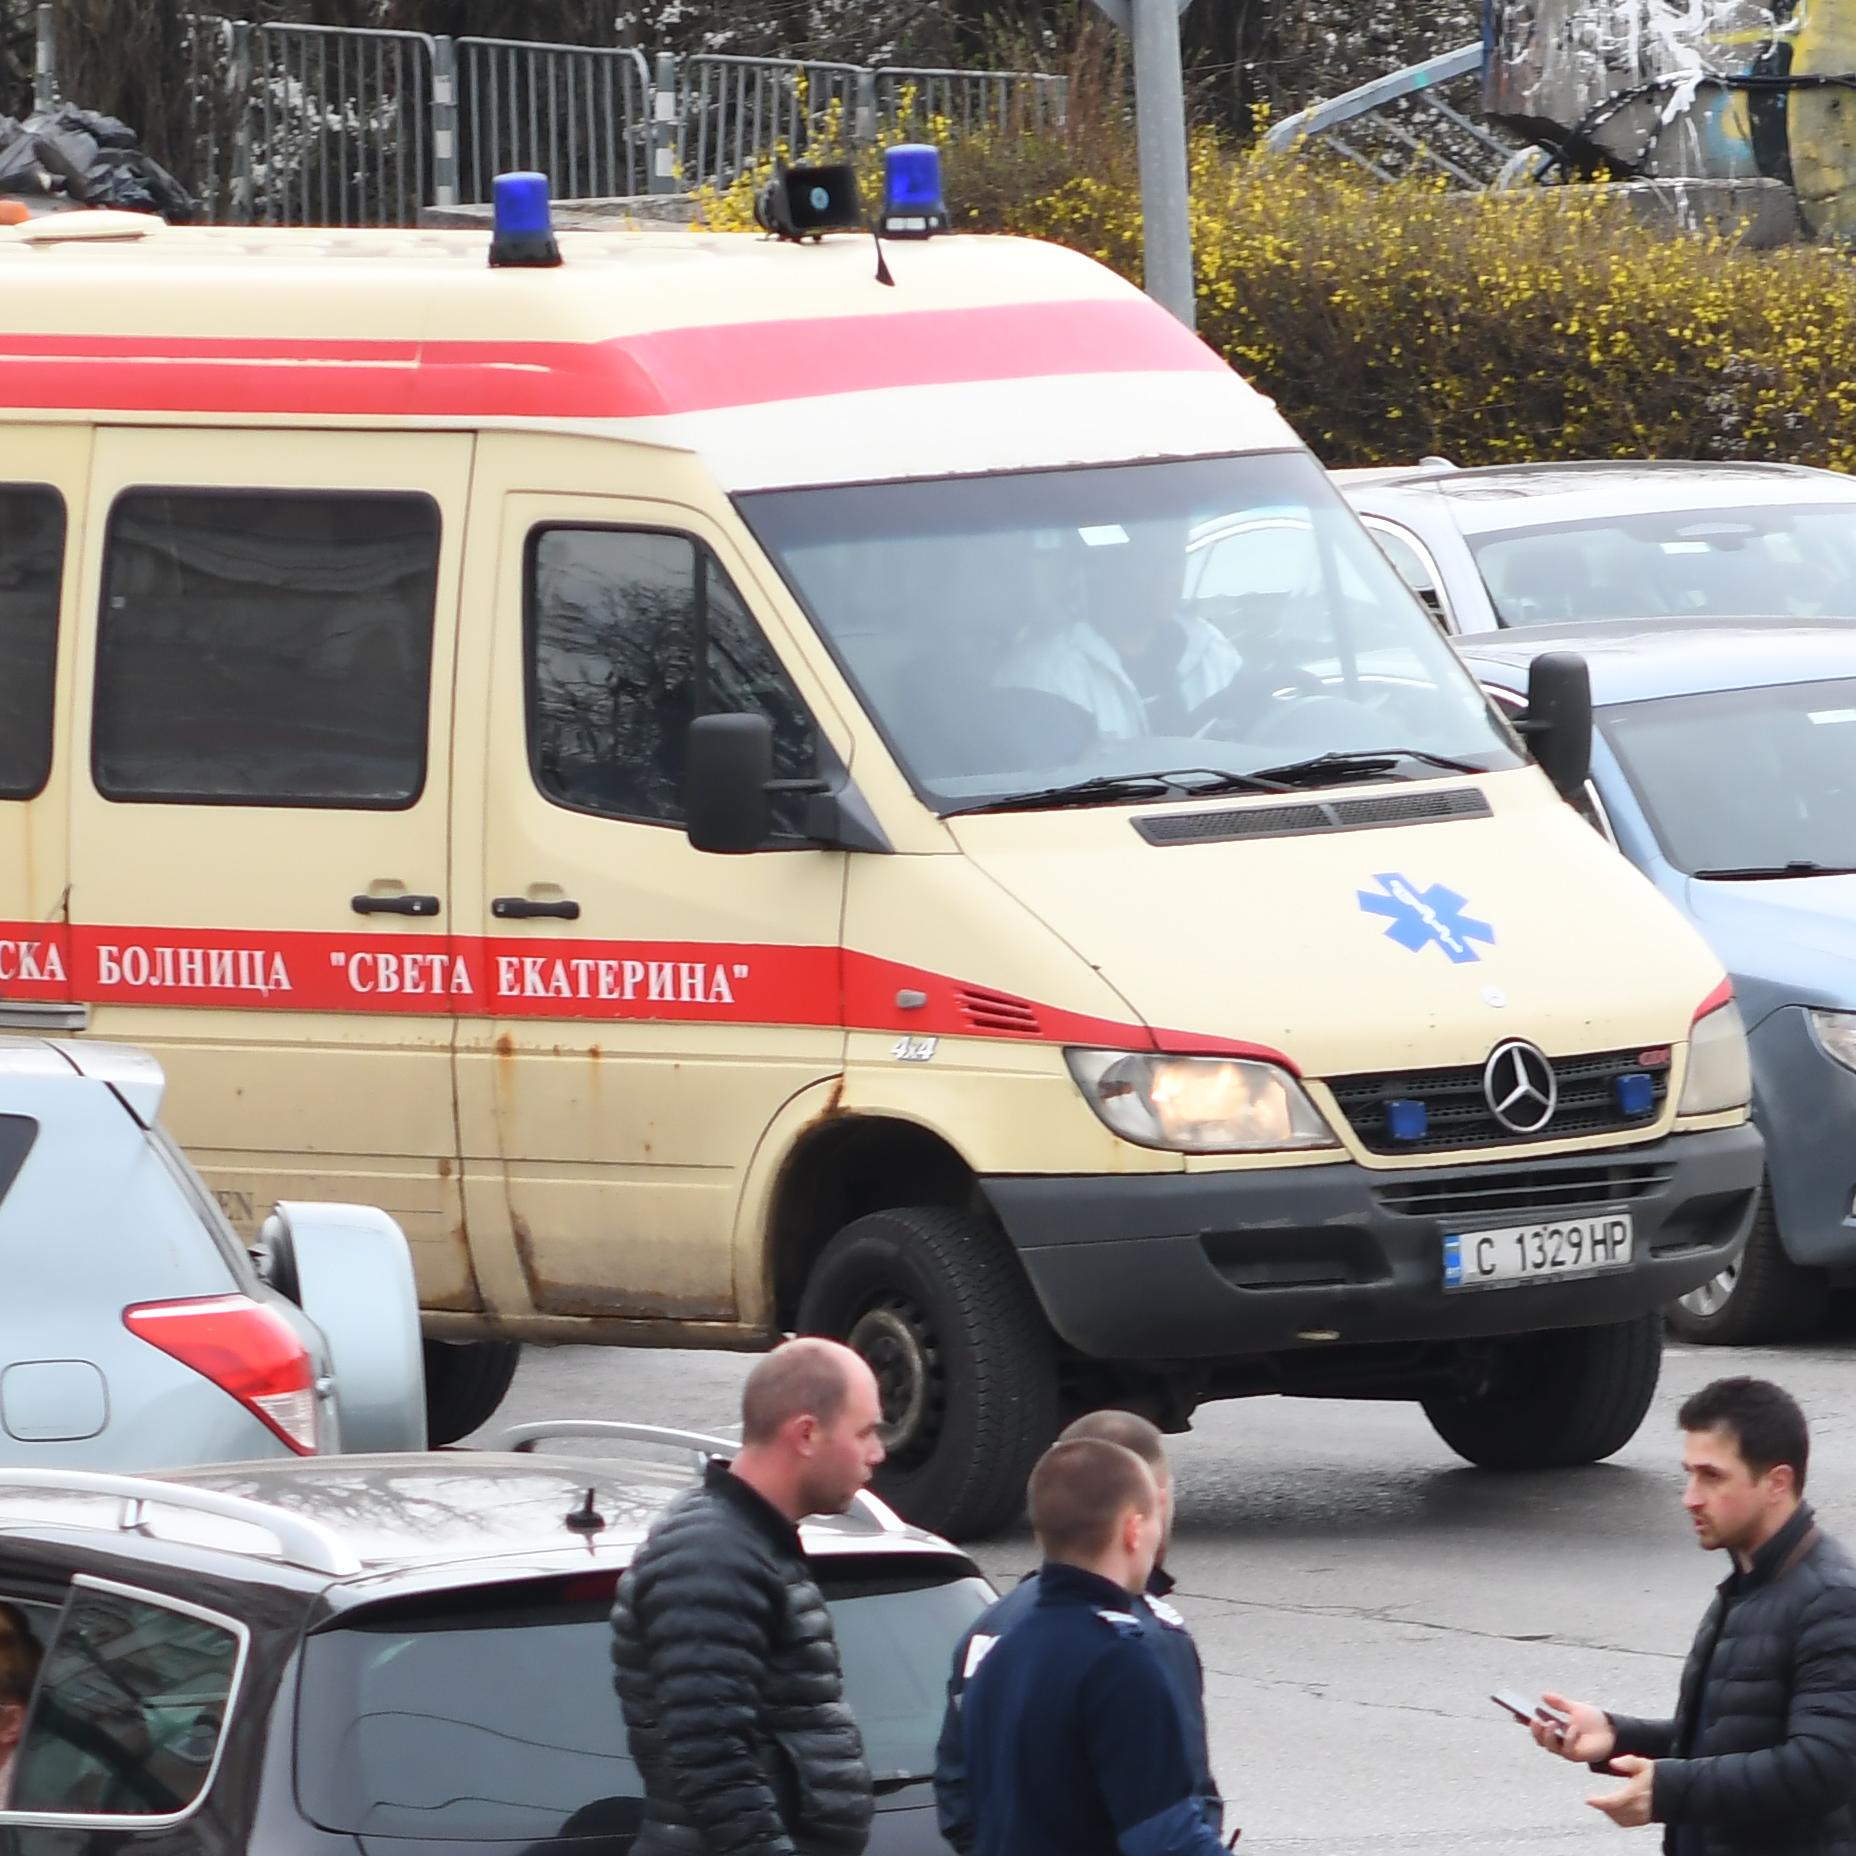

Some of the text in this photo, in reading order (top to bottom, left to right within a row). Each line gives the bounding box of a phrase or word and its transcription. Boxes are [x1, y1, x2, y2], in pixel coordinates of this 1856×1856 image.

[96, 946, 293, 997] БОЛНИЦА
[330, 952, 473, 994] "СВЕТА
[496, 956, 749, 1003] ЕКАТЕРИНА"
[1476, 1237, 1496, 1276] C
